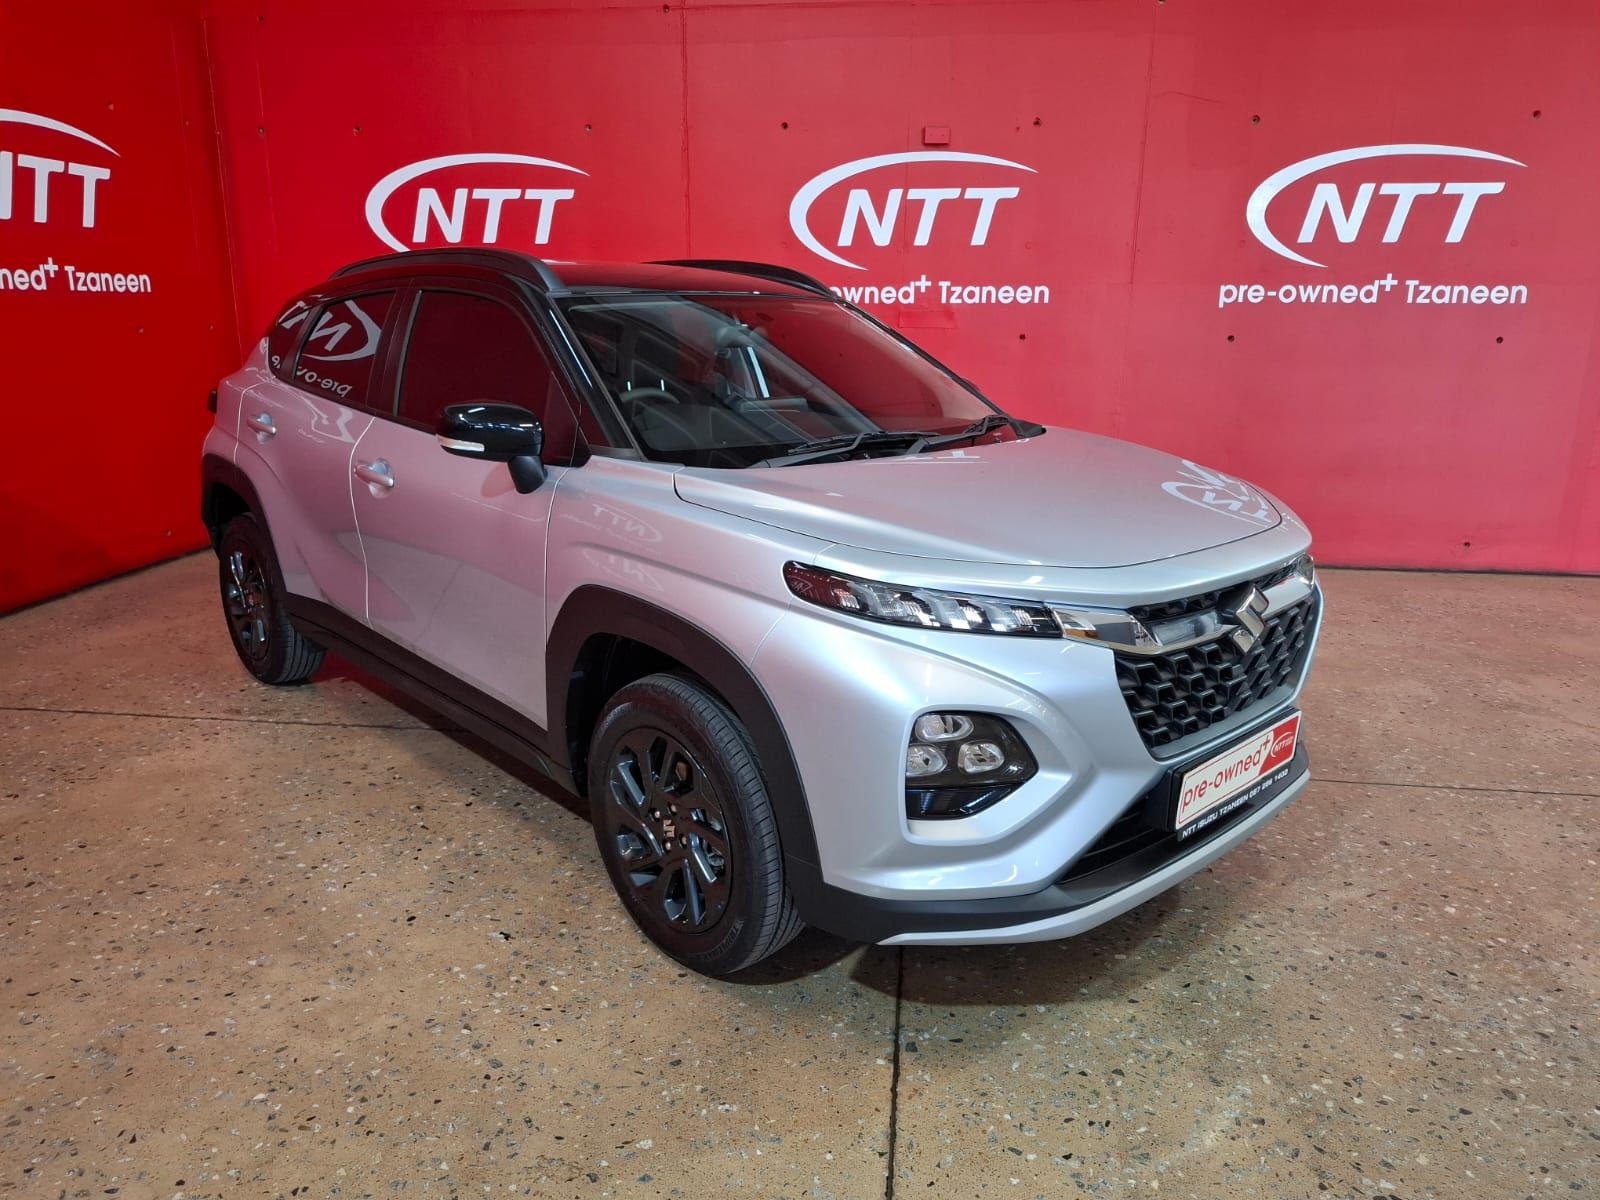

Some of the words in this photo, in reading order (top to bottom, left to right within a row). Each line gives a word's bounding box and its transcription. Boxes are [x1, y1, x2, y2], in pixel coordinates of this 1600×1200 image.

[0, 151, 111, 228] TT
[412, 187, 575, 245] NTT
[837, 187, 1020, 246] NTT
[1297, 182, 1506, 243] NTT
[64, 265, 152, 293] Tzaneen
[938, 281, 1050, 304] Tzaneen
[1405, 280, 1528, 304] Tzaneen
[1182, 824, 1197, 839] NTT
